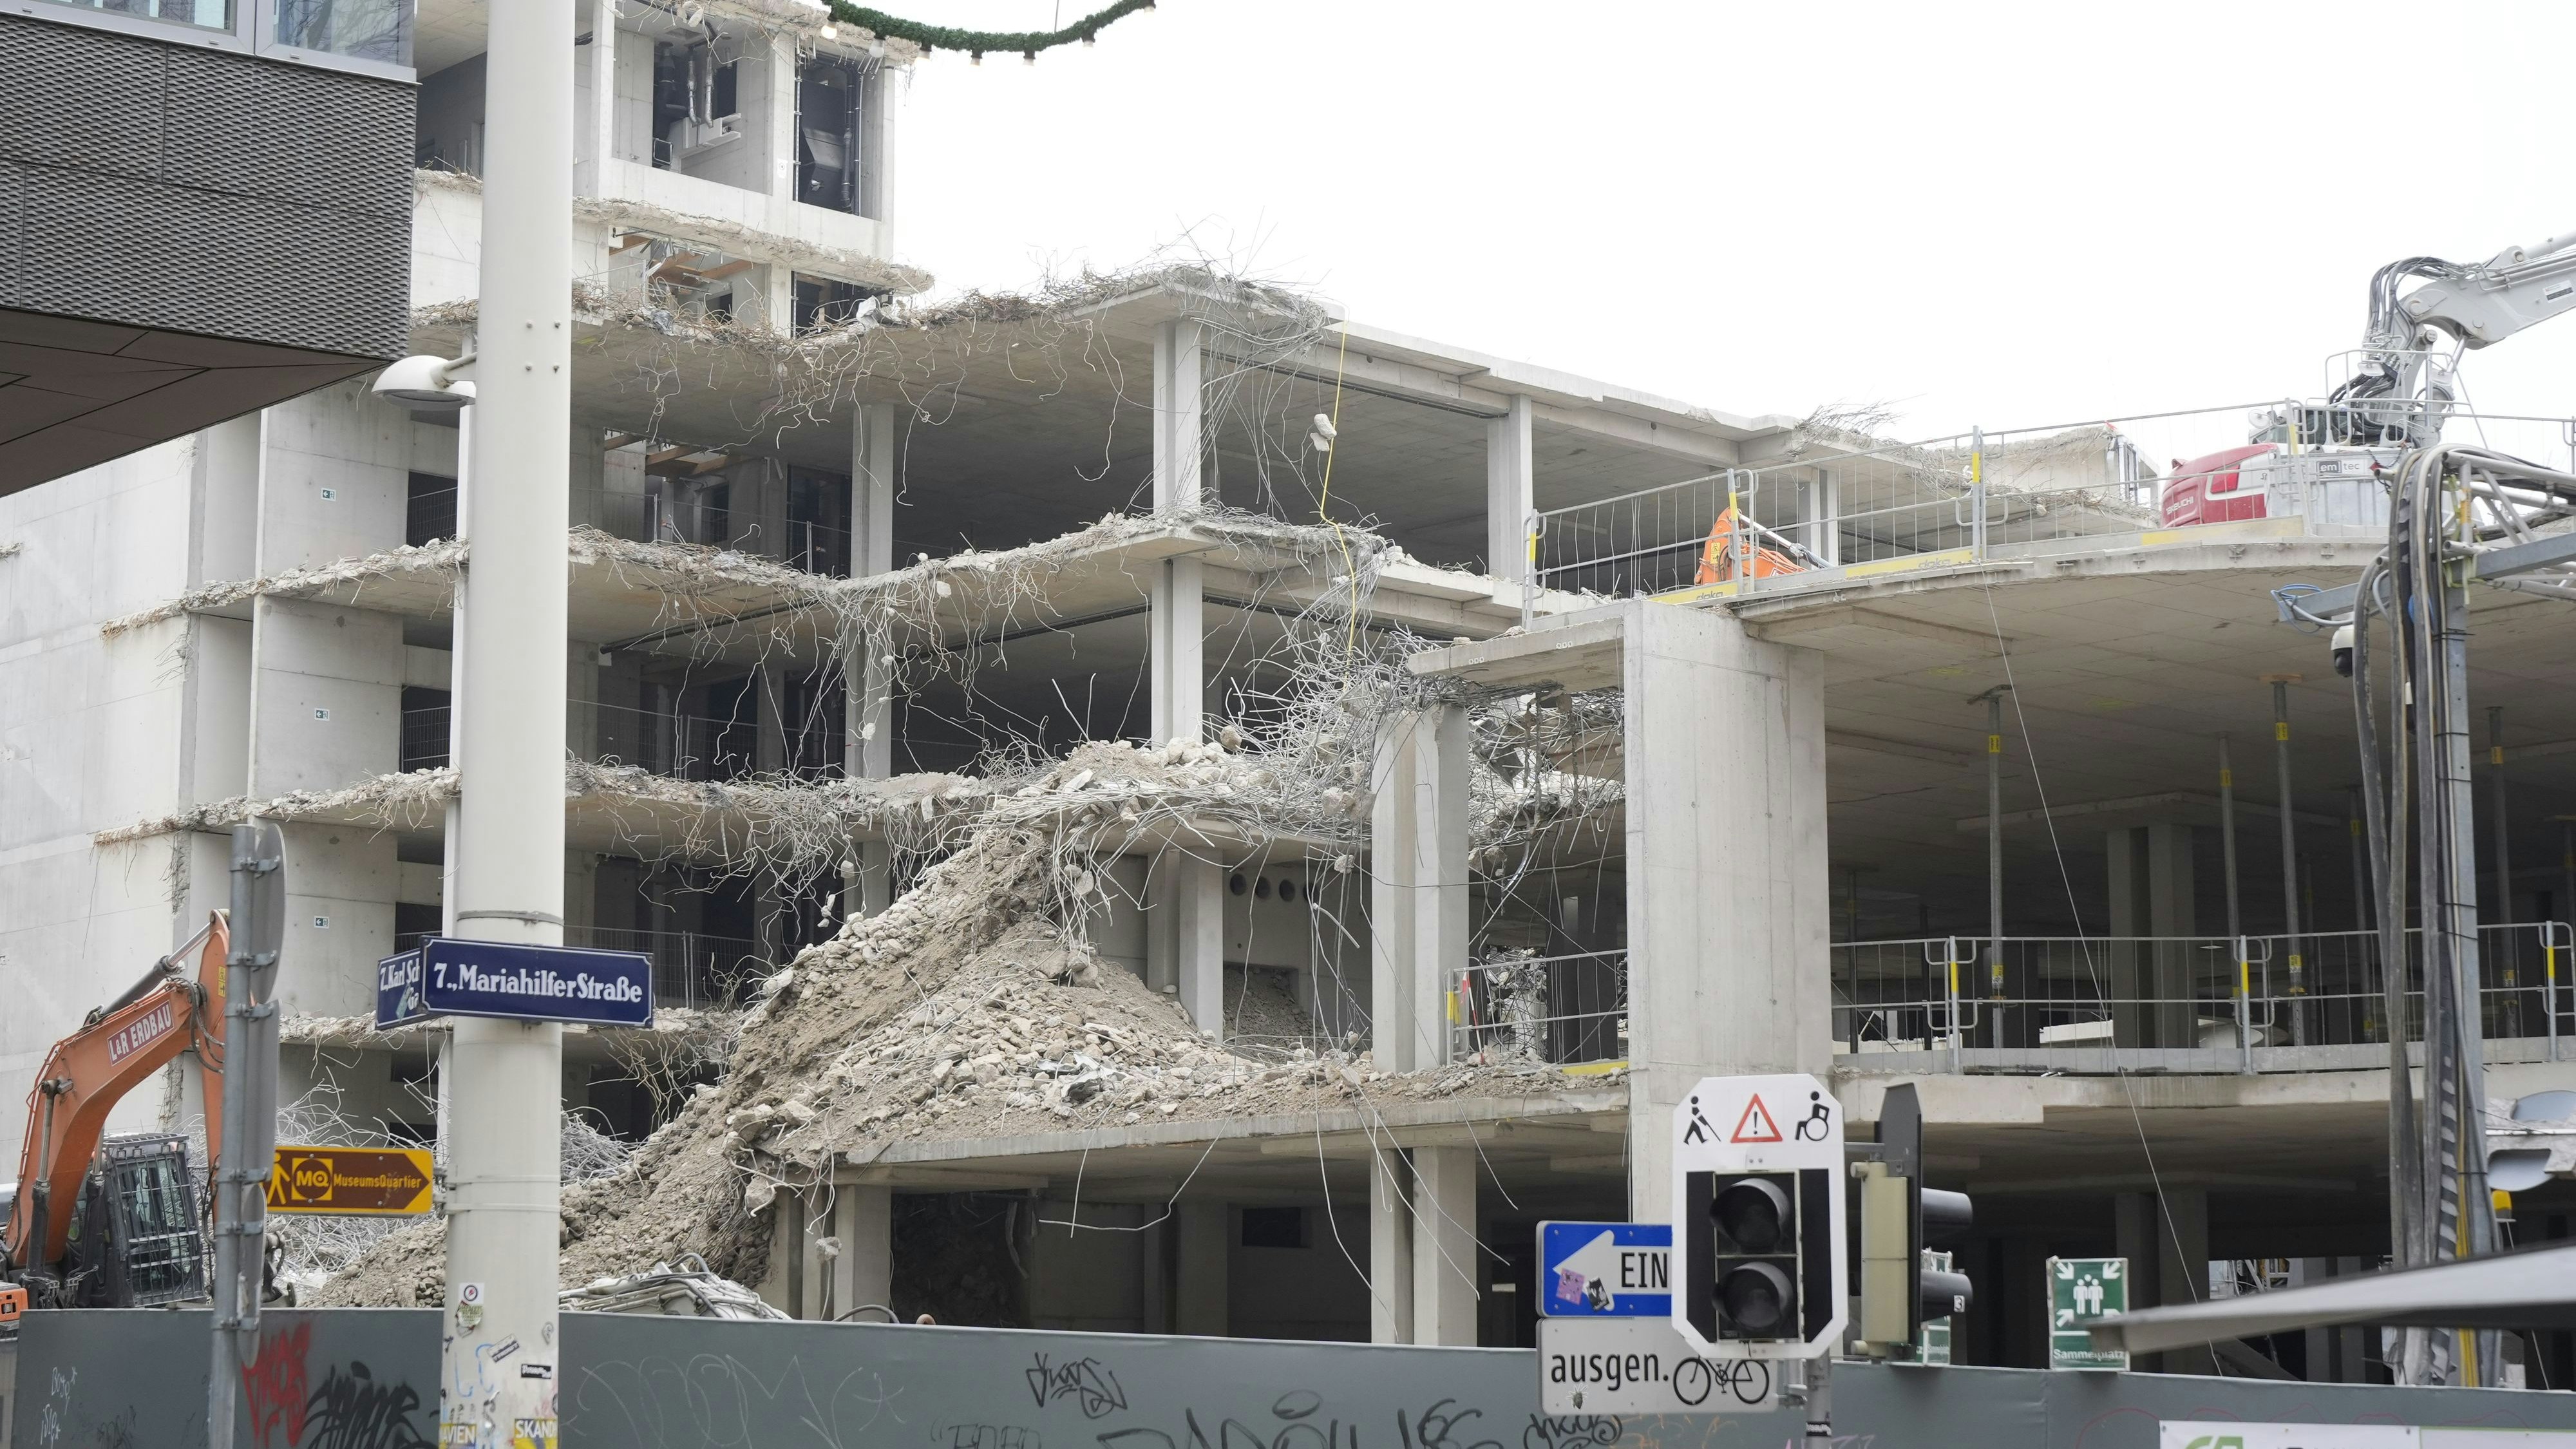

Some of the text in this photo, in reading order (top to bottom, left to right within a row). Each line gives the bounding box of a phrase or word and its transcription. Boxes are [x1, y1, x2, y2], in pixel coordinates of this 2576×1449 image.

[109, 1003, 172, 1062] L&R ERDBAU
[296, 1170, 422, 1189] MQ MuseumsQuartier
[1620, 1251, 1668, 1288] EIN
[1955, 1296, 1963, 1311] 3
[1550, 1353, 1669, 1391] ausgen.
